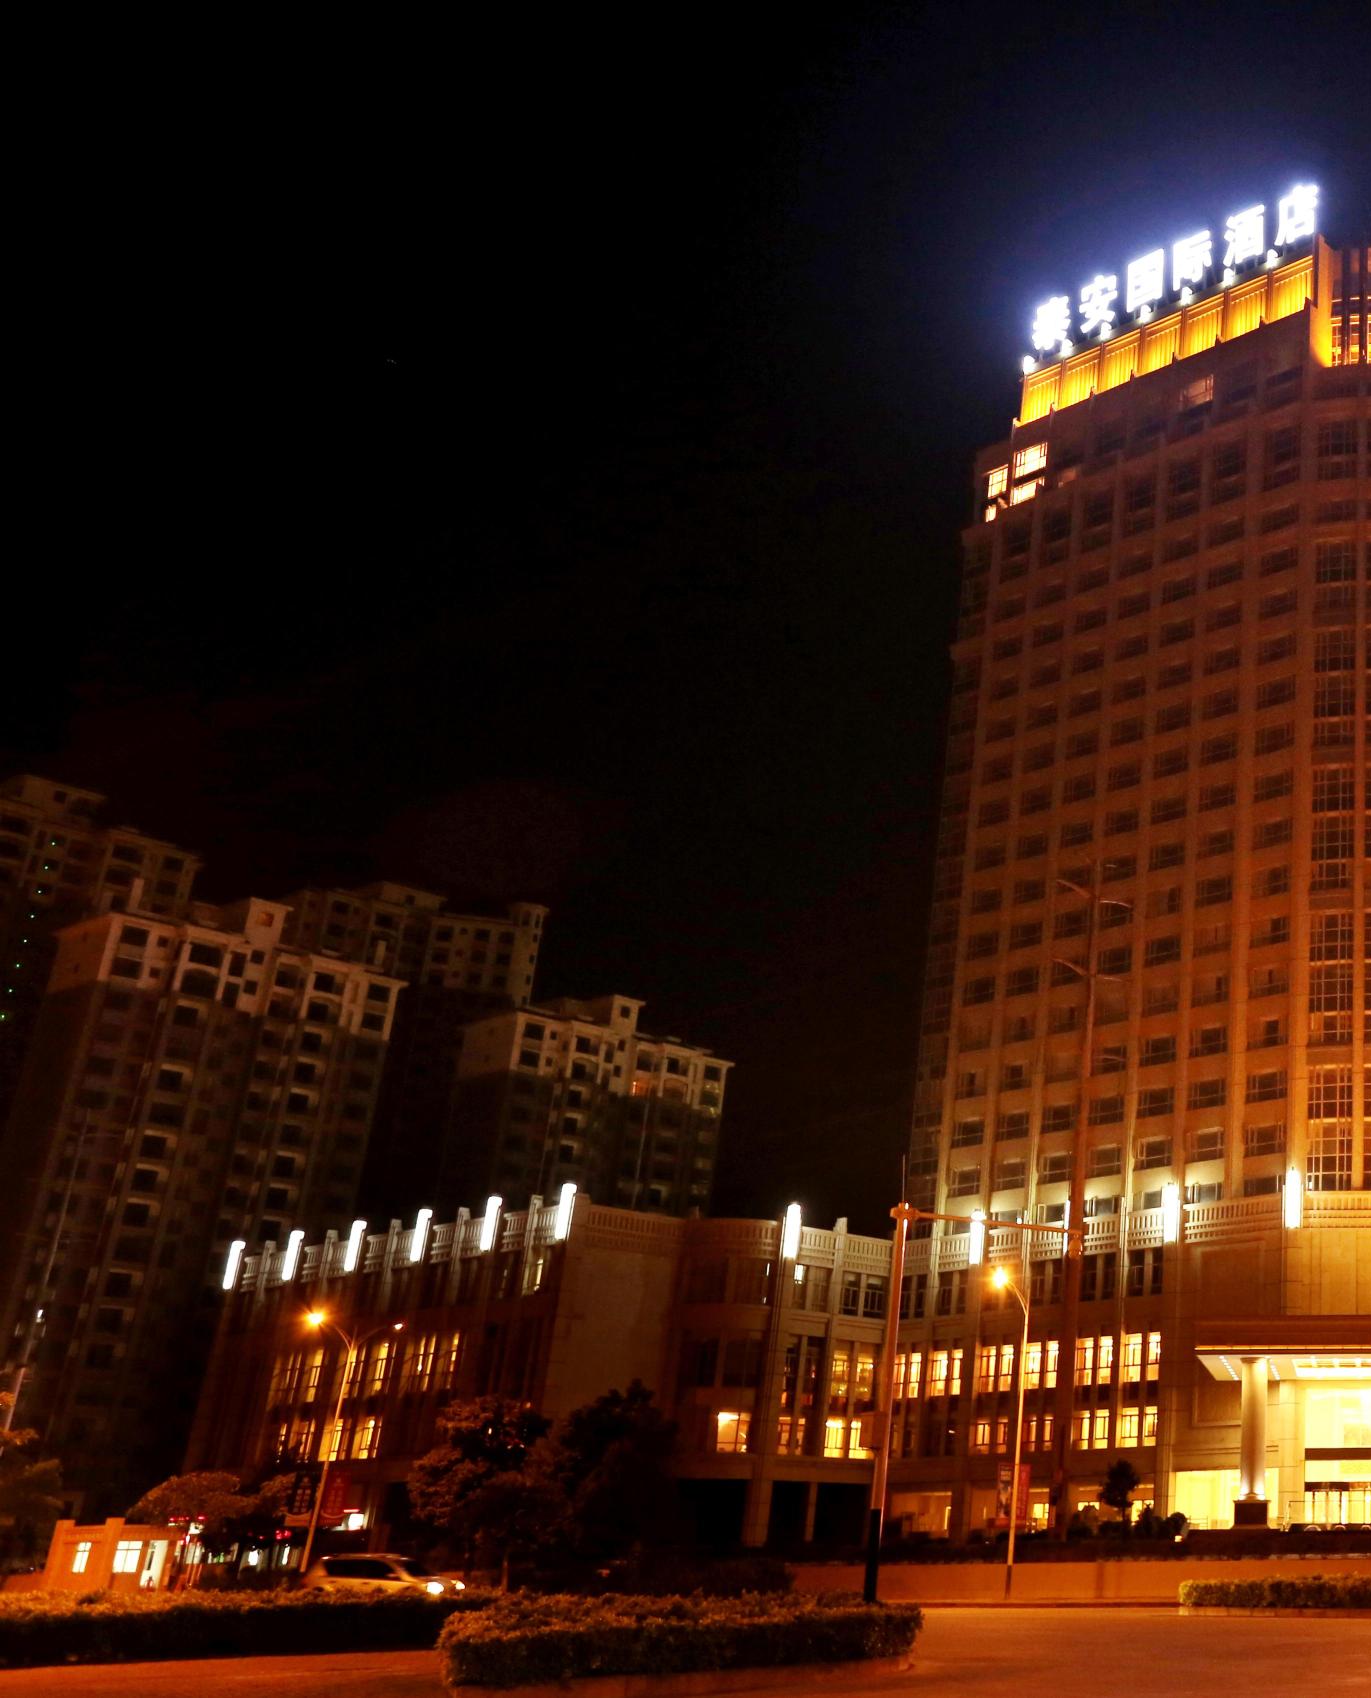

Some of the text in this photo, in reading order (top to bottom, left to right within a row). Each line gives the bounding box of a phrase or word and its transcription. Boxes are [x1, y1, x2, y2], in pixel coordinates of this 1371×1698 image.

[1032, 184, 1319, 350] 泰安国际酒店
